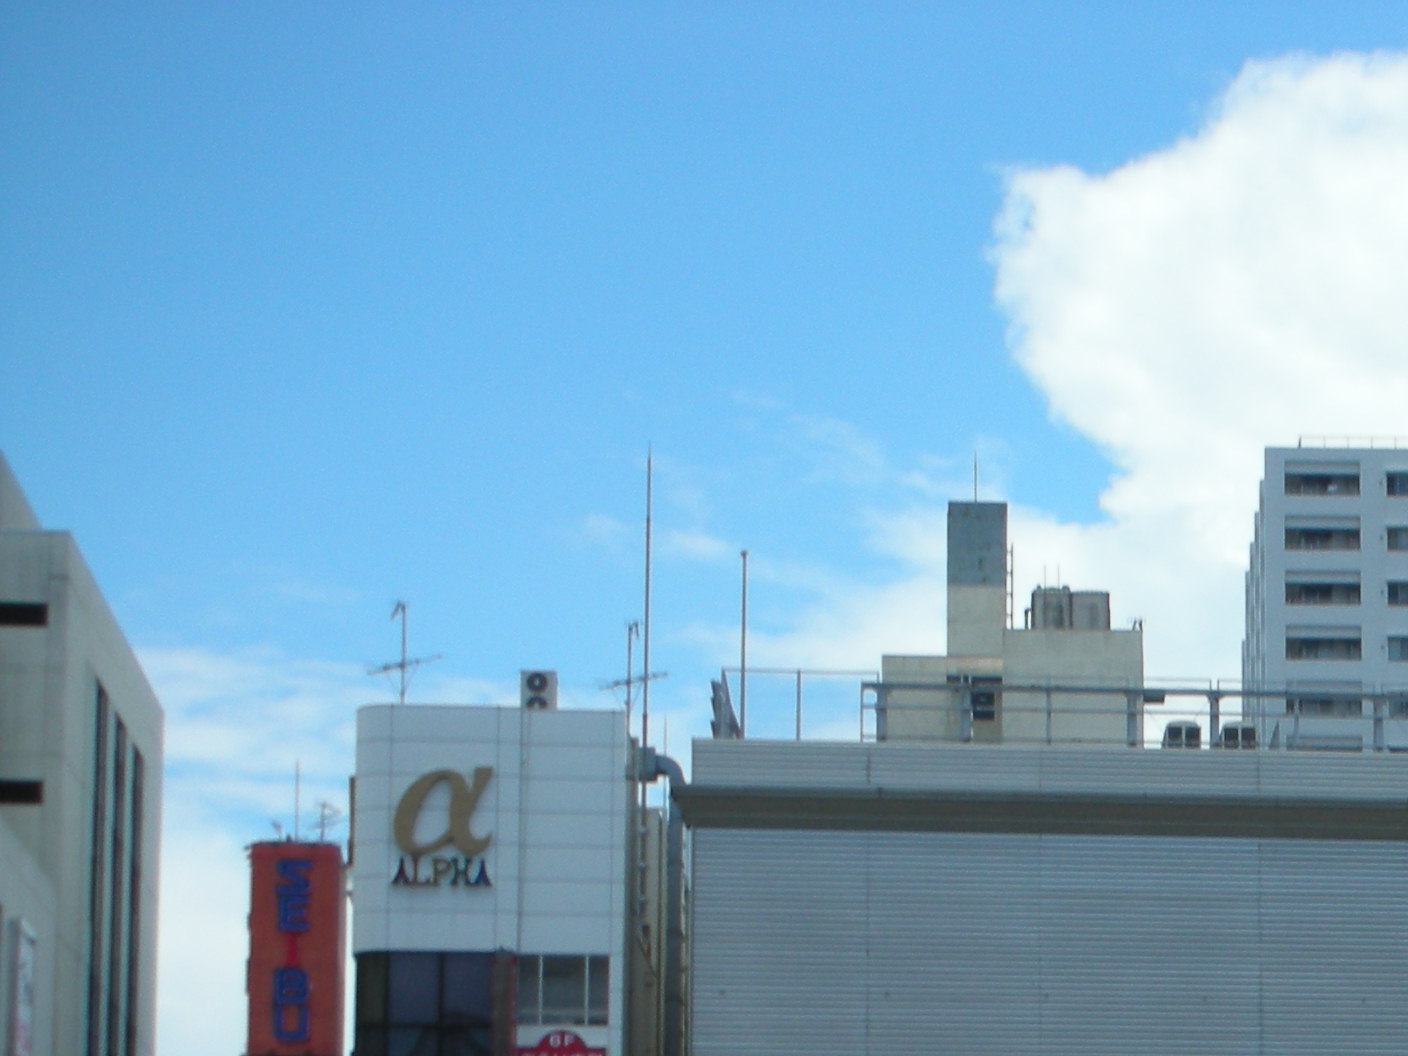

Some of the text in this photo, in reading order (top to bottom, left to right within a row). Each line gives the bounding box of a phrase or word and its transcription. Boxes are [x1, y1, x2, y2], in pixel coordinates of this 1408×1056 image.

[390, 855, 493, 887] ALPHA
[274, 860, 314, 1042] SEIBU
[549, 1034, 575, 1048] 6F
